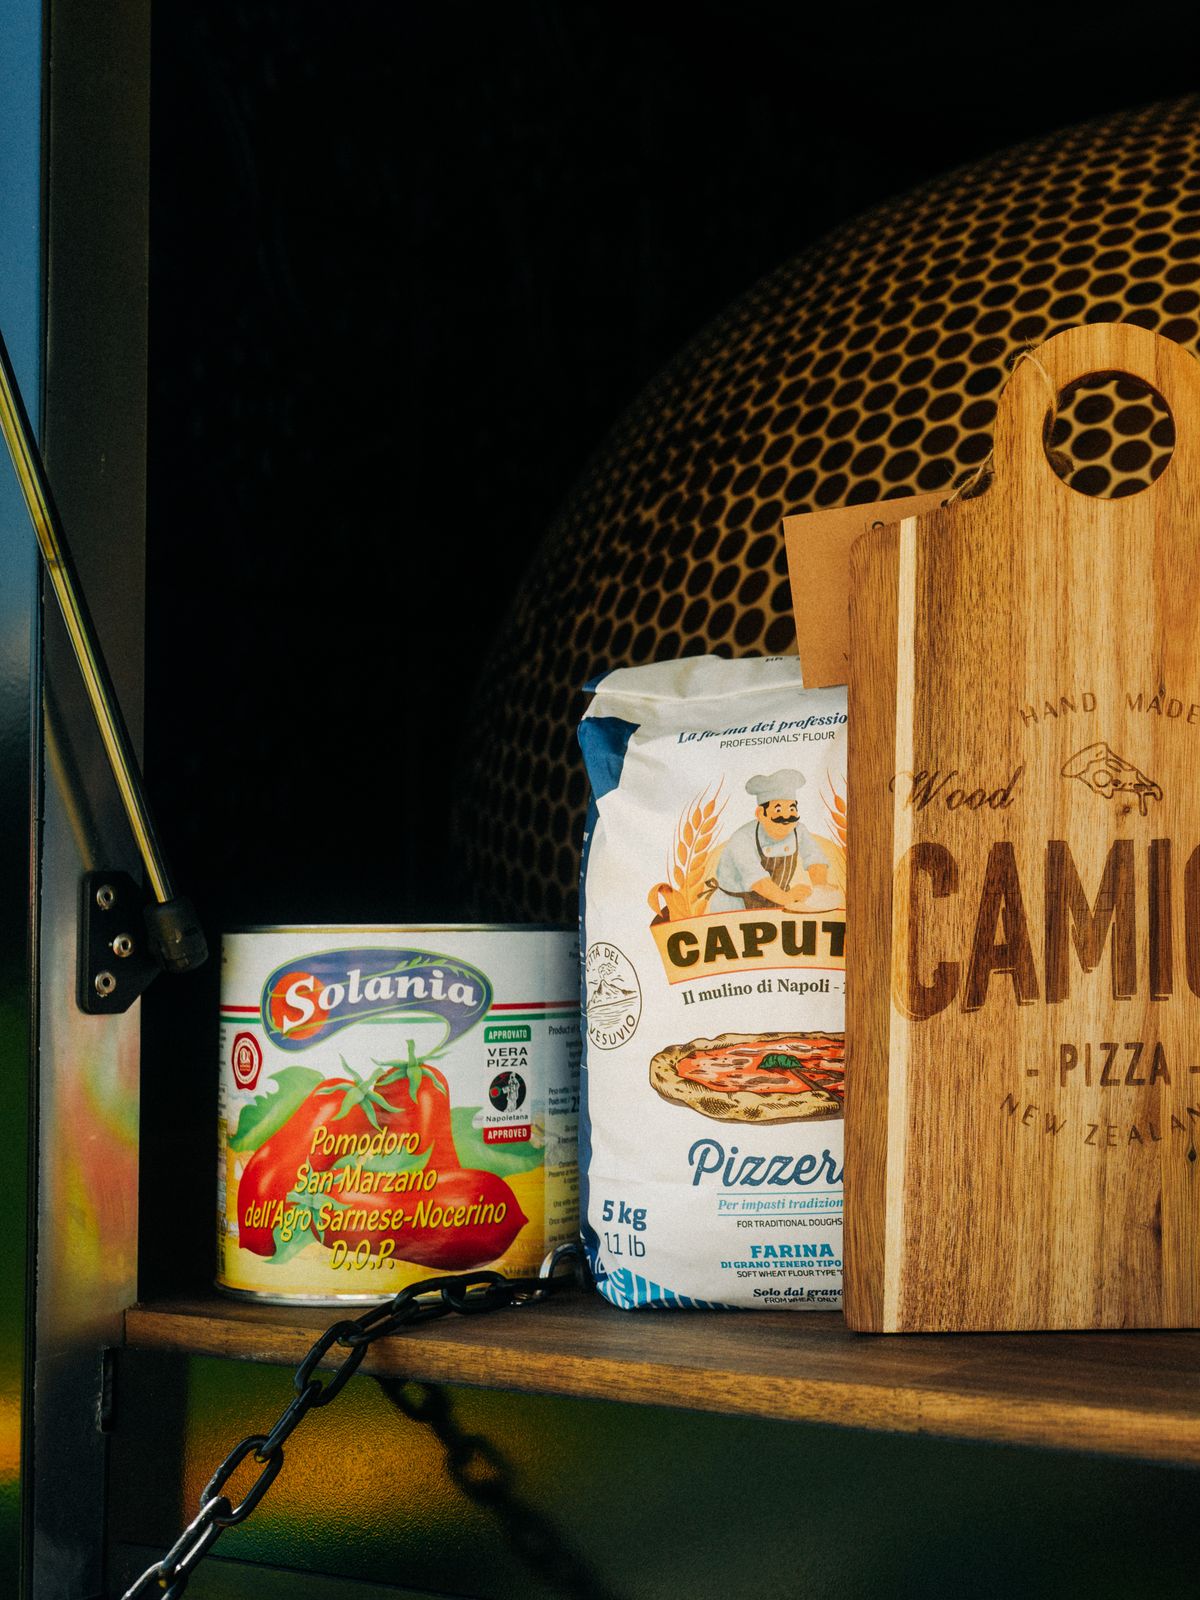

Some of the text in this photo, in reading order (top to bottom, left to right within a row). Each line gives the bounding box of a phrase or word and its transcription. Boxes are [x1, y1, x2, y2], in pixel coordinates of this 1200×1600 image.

[1019, 692, 1097, 728] HAND
[677, 731, 696, 744] La
[751, 720, 776, 733] dei
[777, 712, 848, 733] professio
[802, 731, 835, 742] FLOUR
[889, 765, 1024, 811] Wood
[604, 947, 619, 965] DEL
[666, 920, 846, 968] CAPUT
[282, 968, 478, 1031] Solania
[682, 990, 696, 1005] Il
[698, 982, 752, 1003] mulino
[757, 979, 772, 994] di
[777, 979, 830, 996] Napoli
[488, 1029, 528, 1040] APPROVATO
[589, 1014, 636, 1045] VESUVIO
[487, 1046, 528, 1057] VERA
[487, 1058, 528, 1068] PIZZA
[1060, 1041, 1172, 1087] PIZZA
[486, 1114, 529, 1123] Napoletana
[1000, 1092, 1067, 1136] NEW
[309, 1125, 421, 1157] Pomodoro
[487, 1127, 528, 1140] APPROVED
[688, 1138, 844, 1187] Pizzer
[294, 1163, 438, 1194] San Marzano
[602, 1199, 614, 1222] 5
[618, 1200, 648, 1232] kg
[718, 1197, 844, 1212] Per impasti tradizion
[244, 1199, 312, 1242] dell'Agro
[316, 1195, 508, 1233] Sarnese-Nocerino
[736, 1218, 843, 1228] FOR TRADITIONAL DOUGHS
[329, 1238, 396, 1271] D.O.P.
[628, 1234, 646, 1257] lb
[750, 1243, 834, 1258] FARINA
[736, 1270, 757, 1278] SOFT
[772, 1260, 814, 1268] TENERO
[753, 1287, 780, 1297] Solo
[784, 1287, 804, 1297] dal
